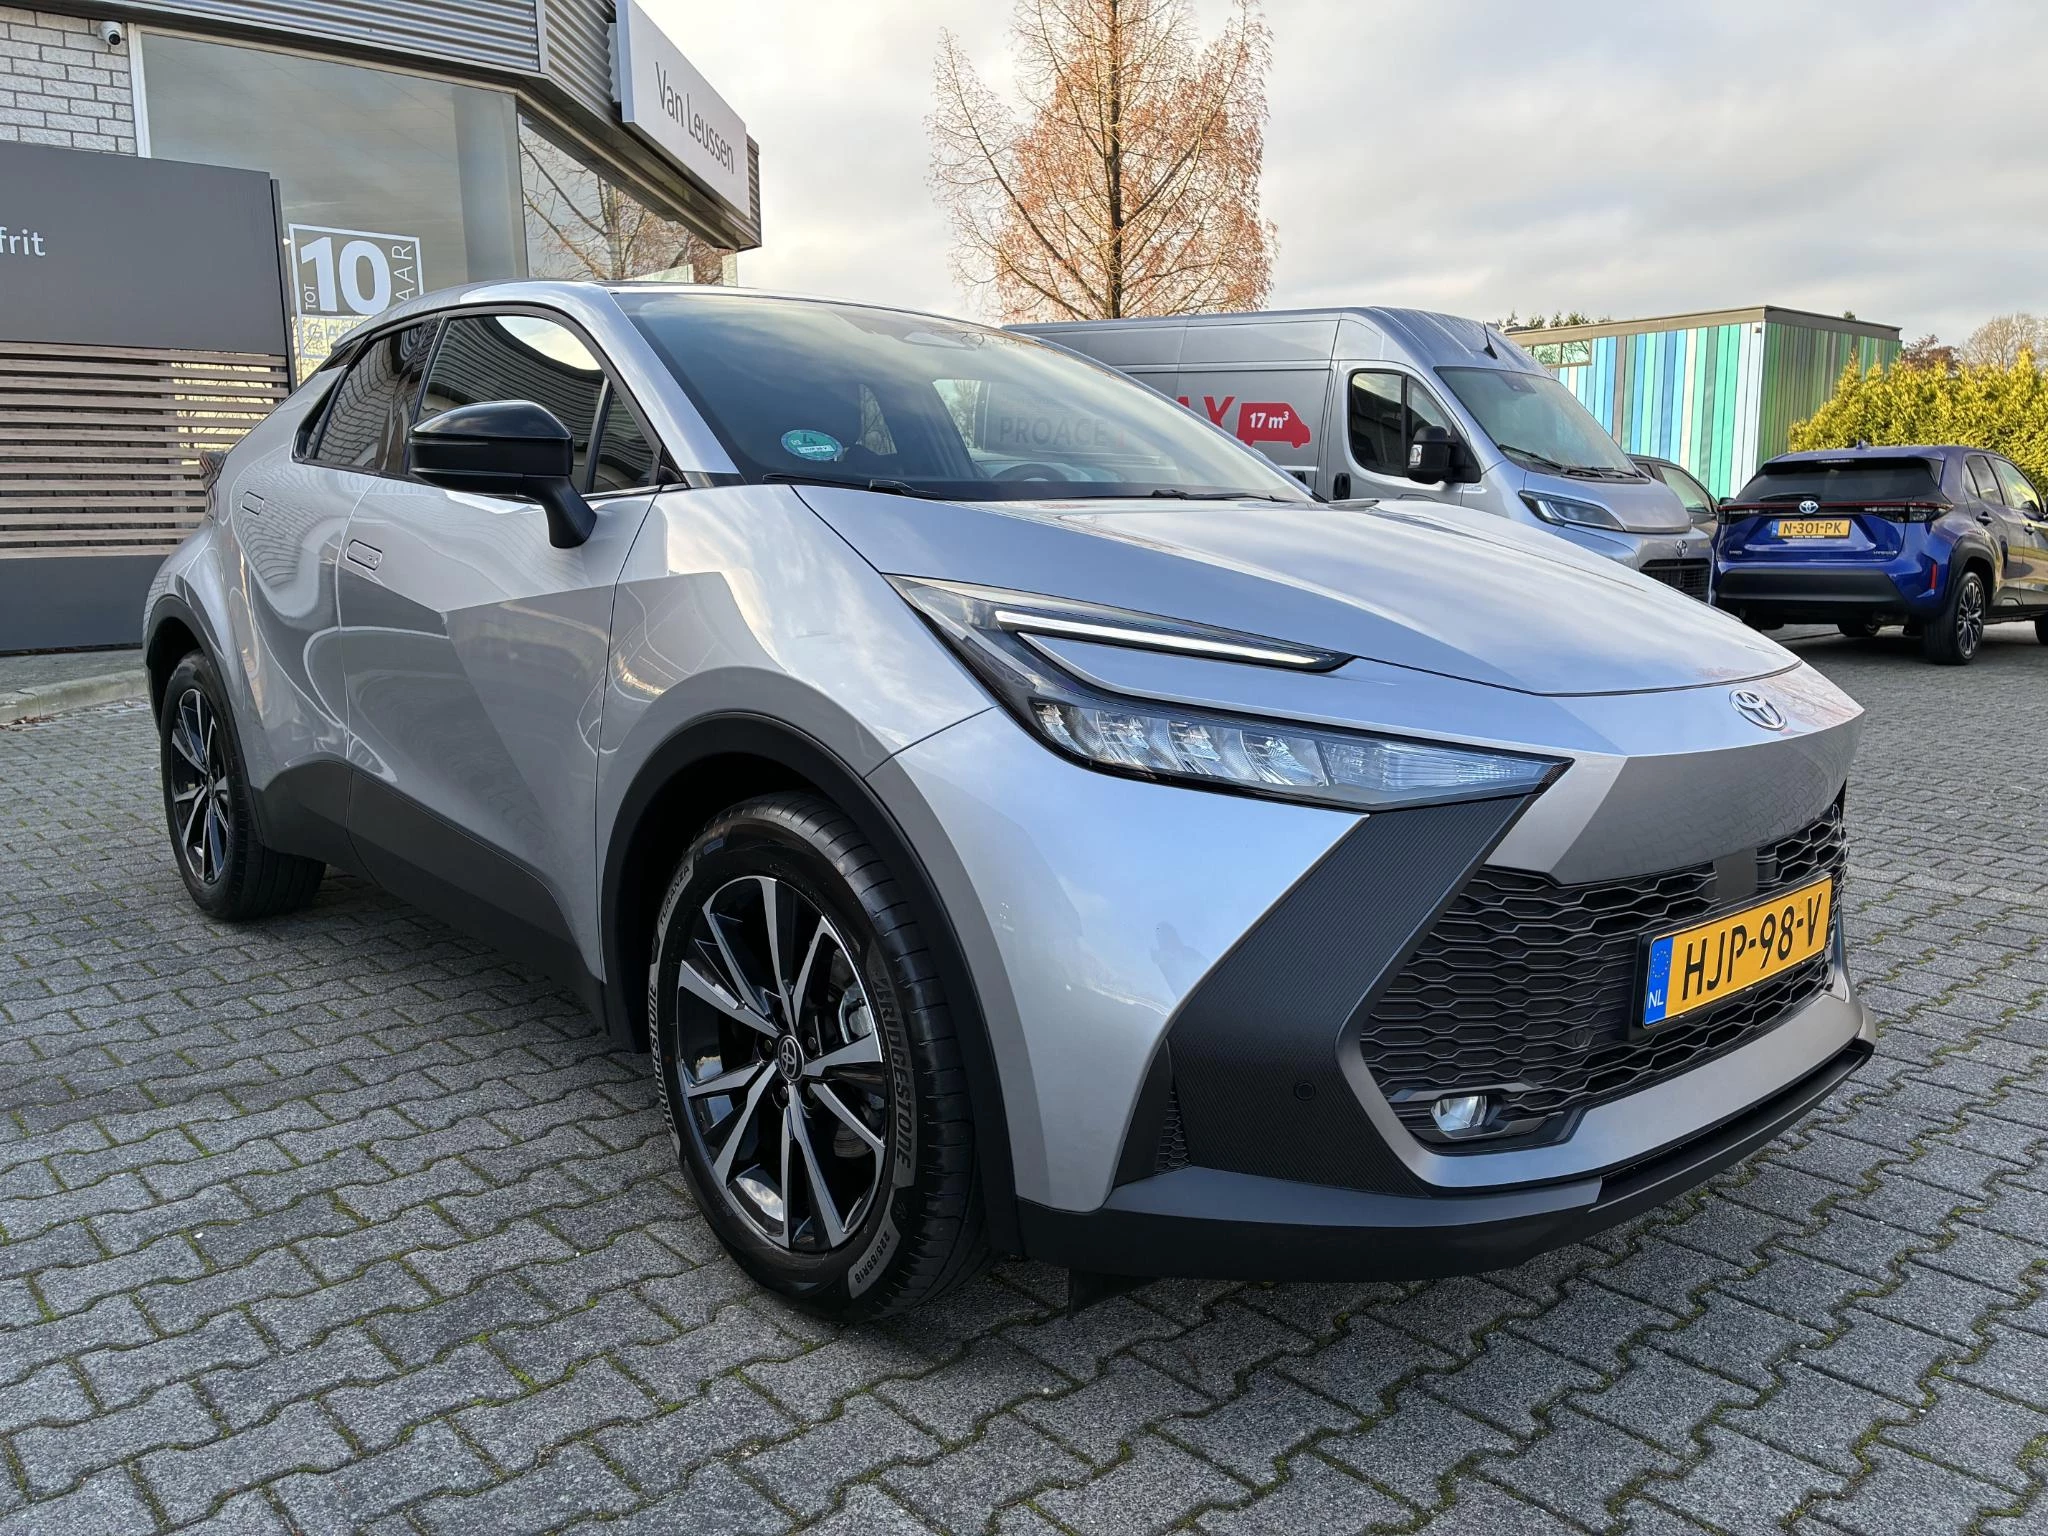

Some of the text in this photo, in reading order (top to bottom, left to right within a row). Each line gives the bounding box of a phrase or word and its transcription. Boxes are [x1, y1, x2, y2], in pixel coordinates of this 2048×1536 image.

[655, 61, 734, 175] Van Leussen
[300, 236, 392, 315] 10
[391, 241, 415, 301] AAR
[303, 283, 317, 310] TOT
[1000, 415, 1107, 446] PROACE
[1249, 412, 1267, 429] 17
[1783, 522, 1842, 534] N-301-PK
[660, 865, 690, 925] TURANZA
[1681, 892, 1823, 1001] HJP-98-V
[1648, 989, 1664, 1009] NL
